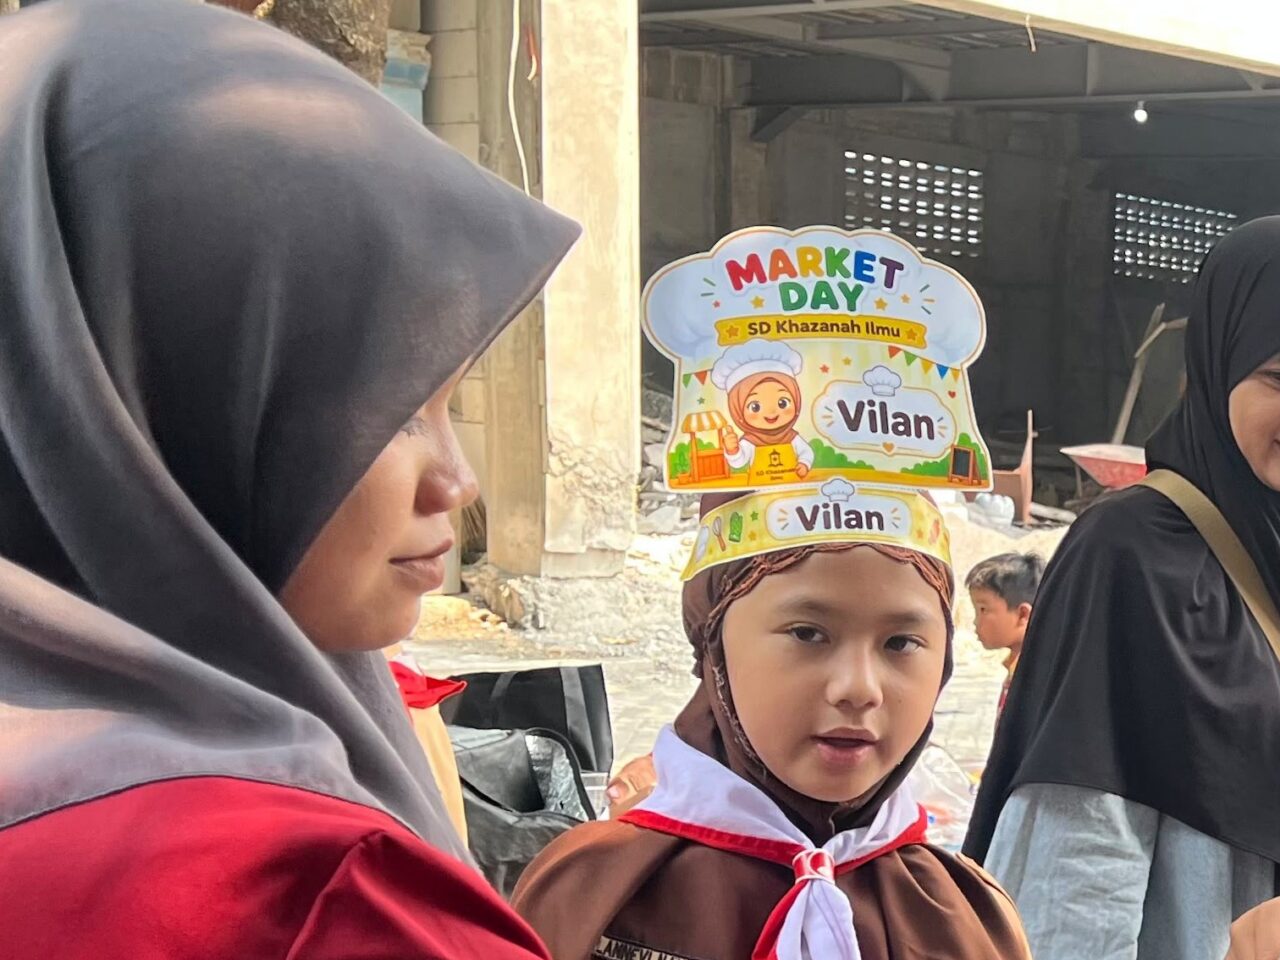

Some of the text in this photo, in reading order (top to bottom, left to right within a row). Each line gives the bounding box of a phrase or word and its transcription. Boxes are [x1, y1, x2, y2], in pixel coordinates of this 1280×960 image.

[725, 246, 905, 291] MARKET
[778, 281, 864, 312] DAY
[747, 319, 900, 338] SD Khazanah Ilmu
[837, 399, 935, 441] Vilan
[795, 504, 885, 531] Vilan
